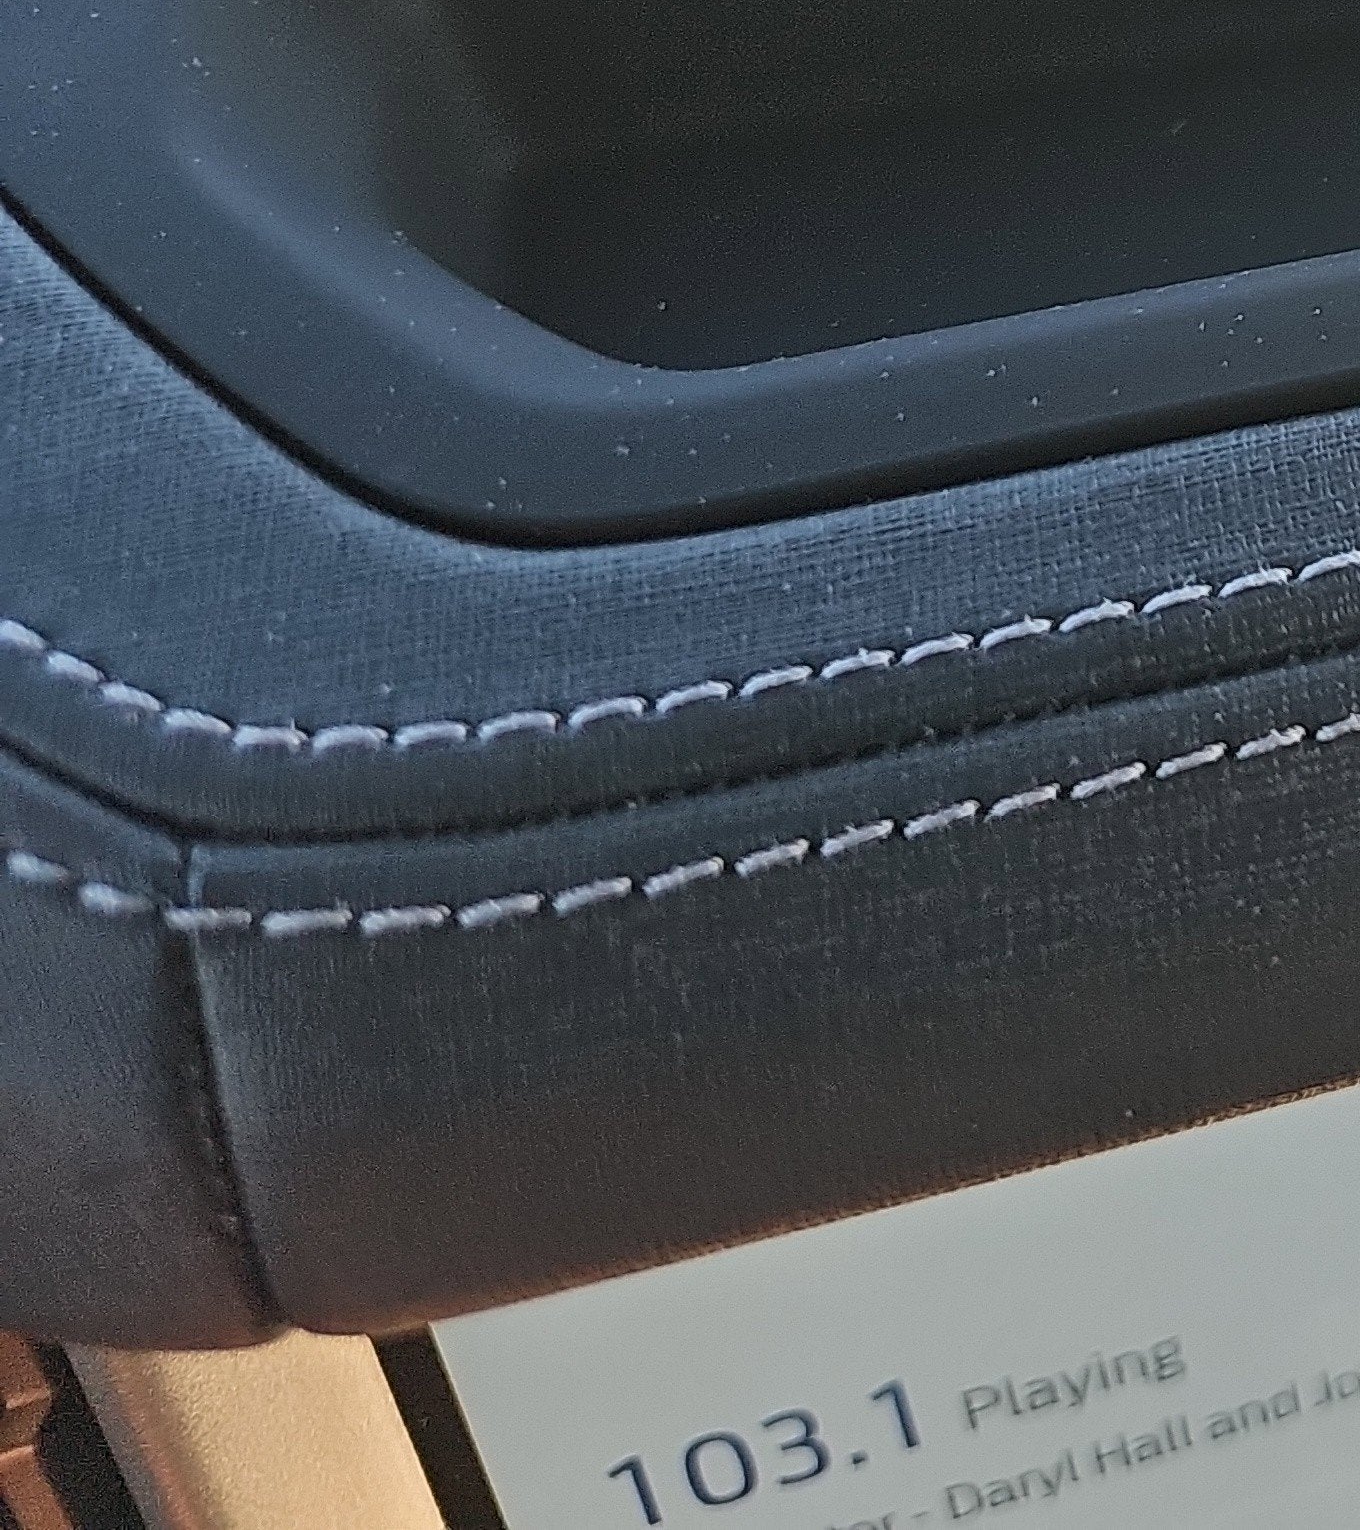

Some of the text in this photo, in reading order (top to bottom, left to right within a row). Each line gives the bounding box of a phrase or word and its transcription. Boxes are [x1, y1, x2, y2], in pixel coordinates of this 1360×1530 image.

[608, 1334, 1186, 1526] 103.1 Playing
[944, 1447, 1081, 1520] Daryl
[1094, 1415, 1194, 1474] Hall
[1206, 1381, 1301, 1442] and
